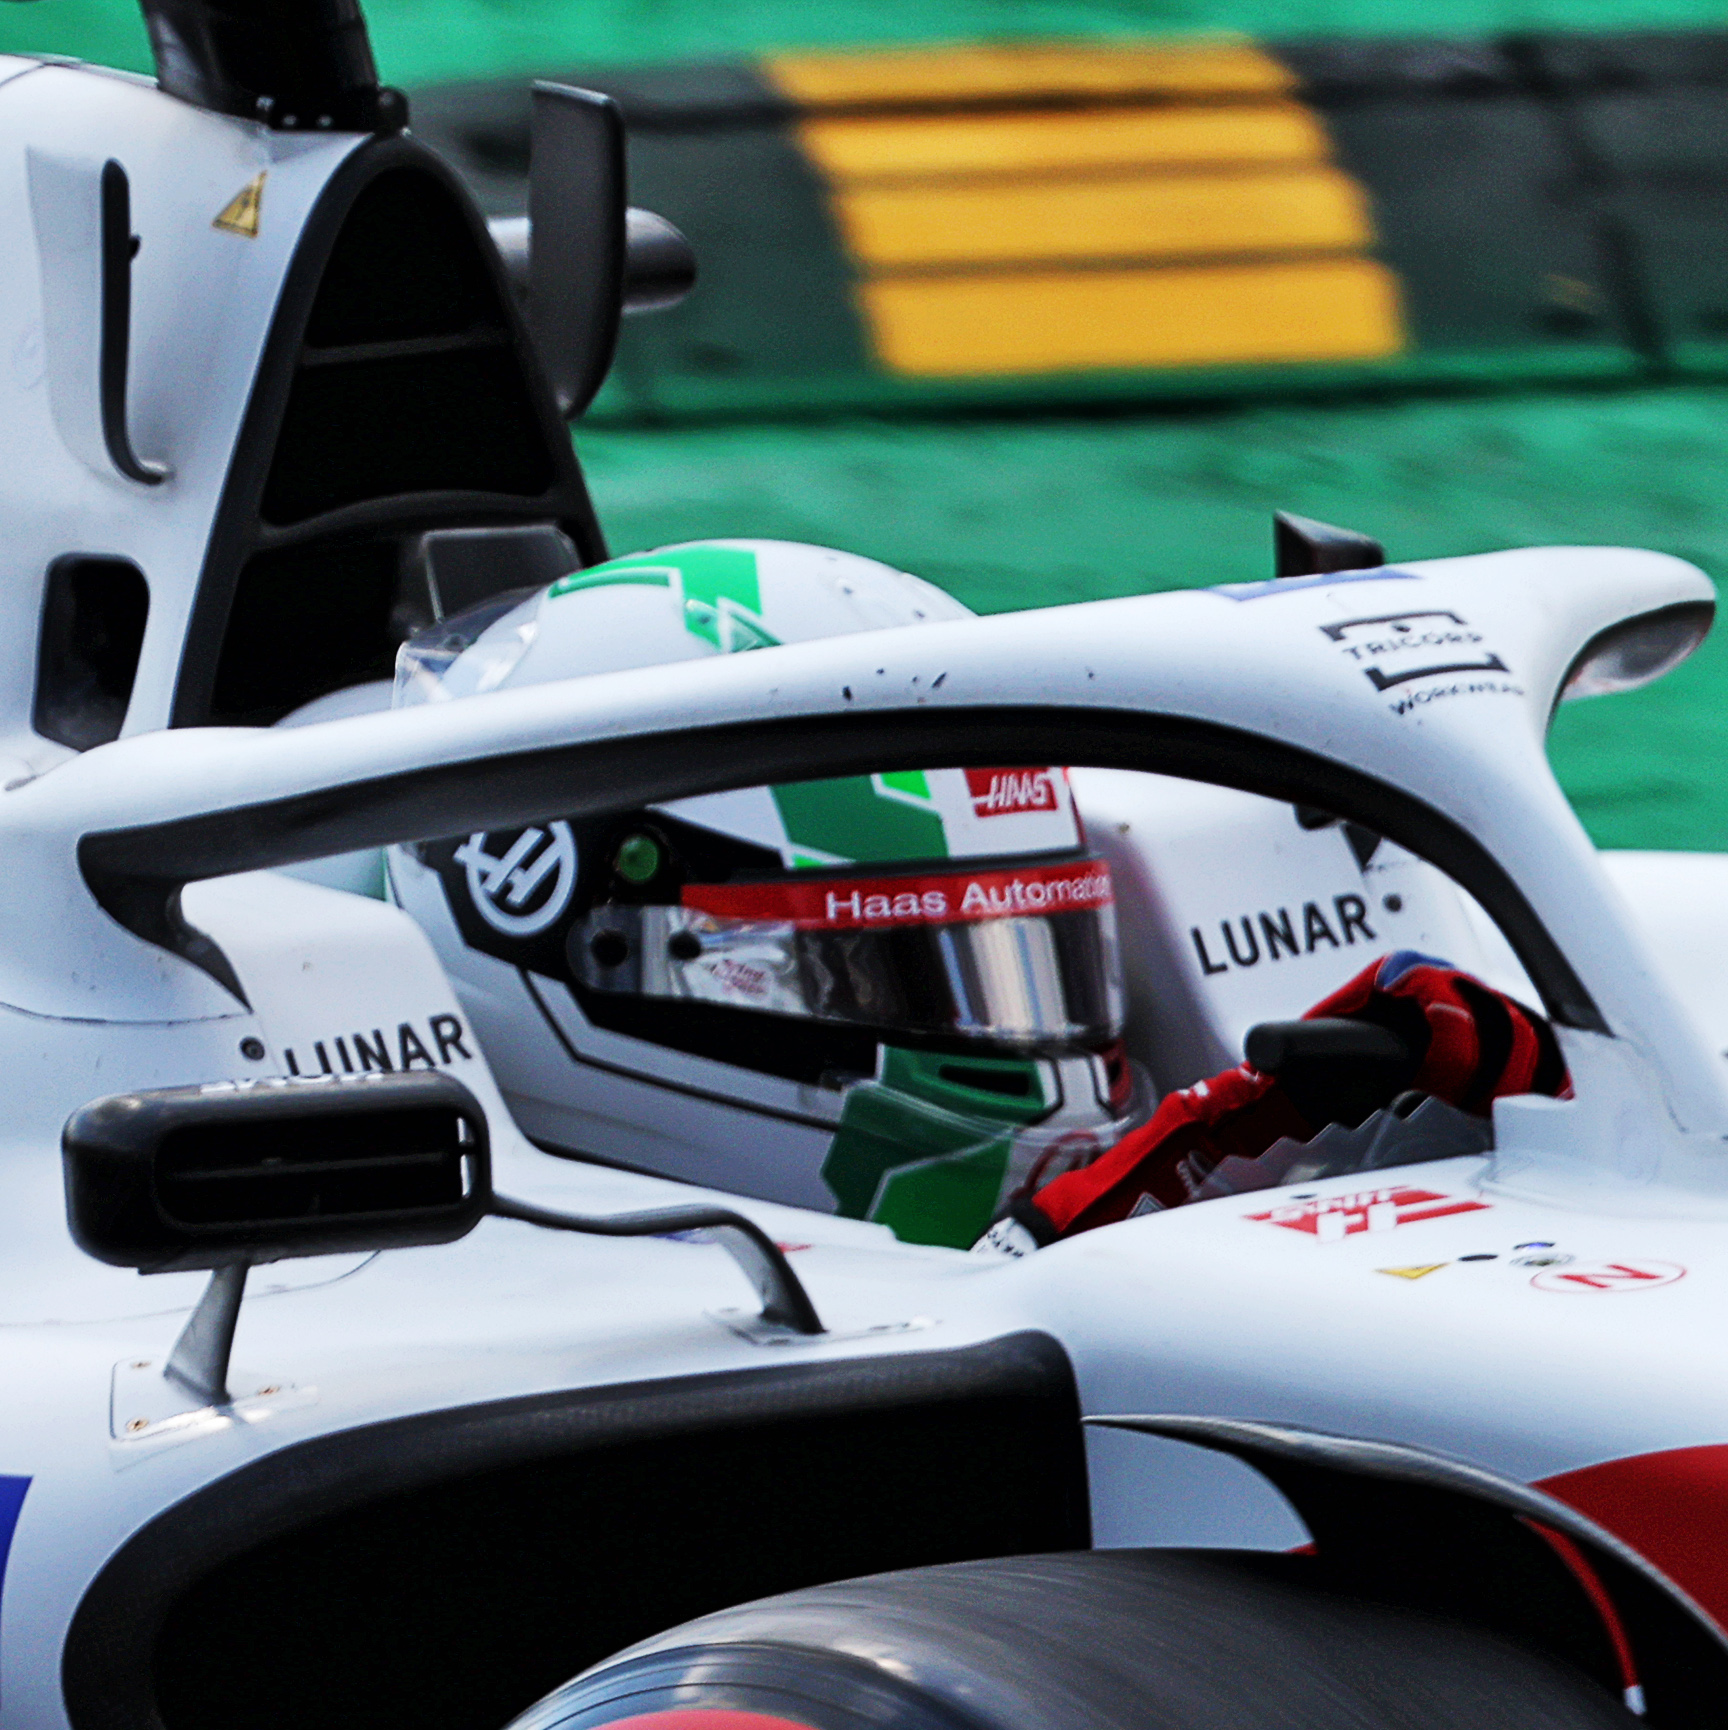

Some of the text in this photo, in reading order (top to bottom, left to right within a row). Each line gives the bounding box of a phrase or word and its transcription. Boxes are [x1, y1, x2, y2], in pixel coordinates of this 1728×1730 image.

[971, 769, 1051, 810] HAAS
[825, 872, 1112, 920] Haas Automatio
[1191, 893, 1377, 976] LUNAR
